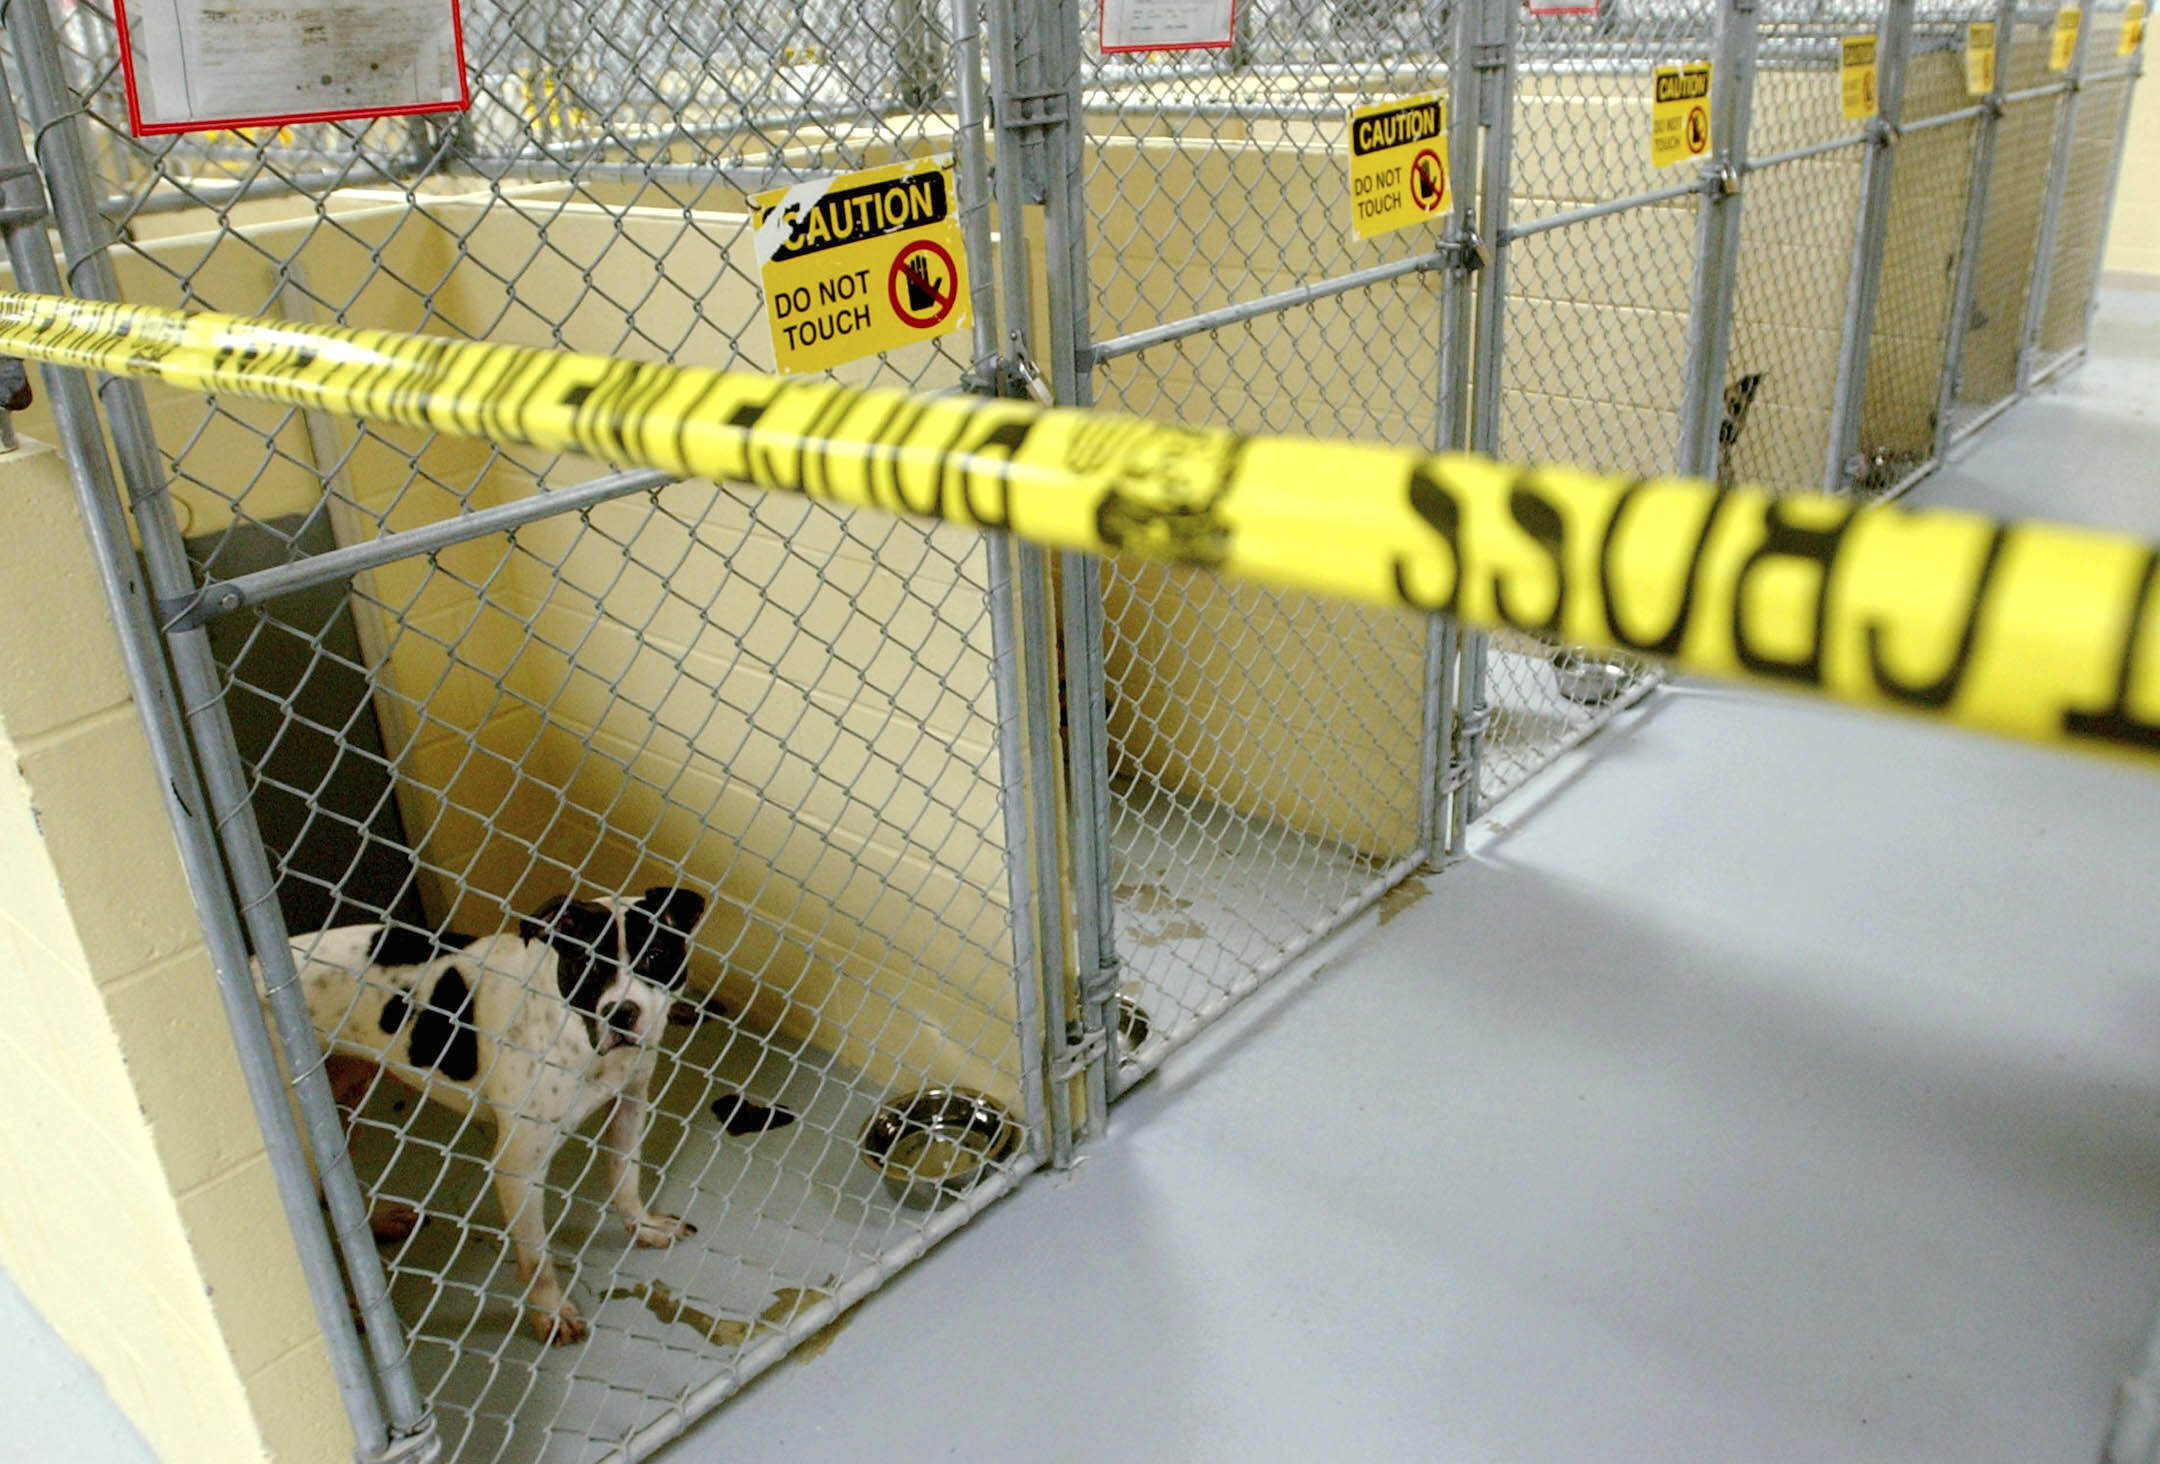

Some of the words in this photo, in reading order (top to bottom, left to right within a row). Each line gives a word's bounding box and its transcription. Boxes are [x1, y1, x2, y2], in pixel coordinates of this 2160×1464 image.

[1359, 108, 1435, 150] CAUTION
[1355, 176, 1373, 196] DO
[1376, 168, 1401, 190] NOT
[1358, 193, 1402, 219] TOUCH
[775, 286, 810, 319] DO
[819, 269, 871, 313] NOT
[783, 304, 872, 351] TOUCH
